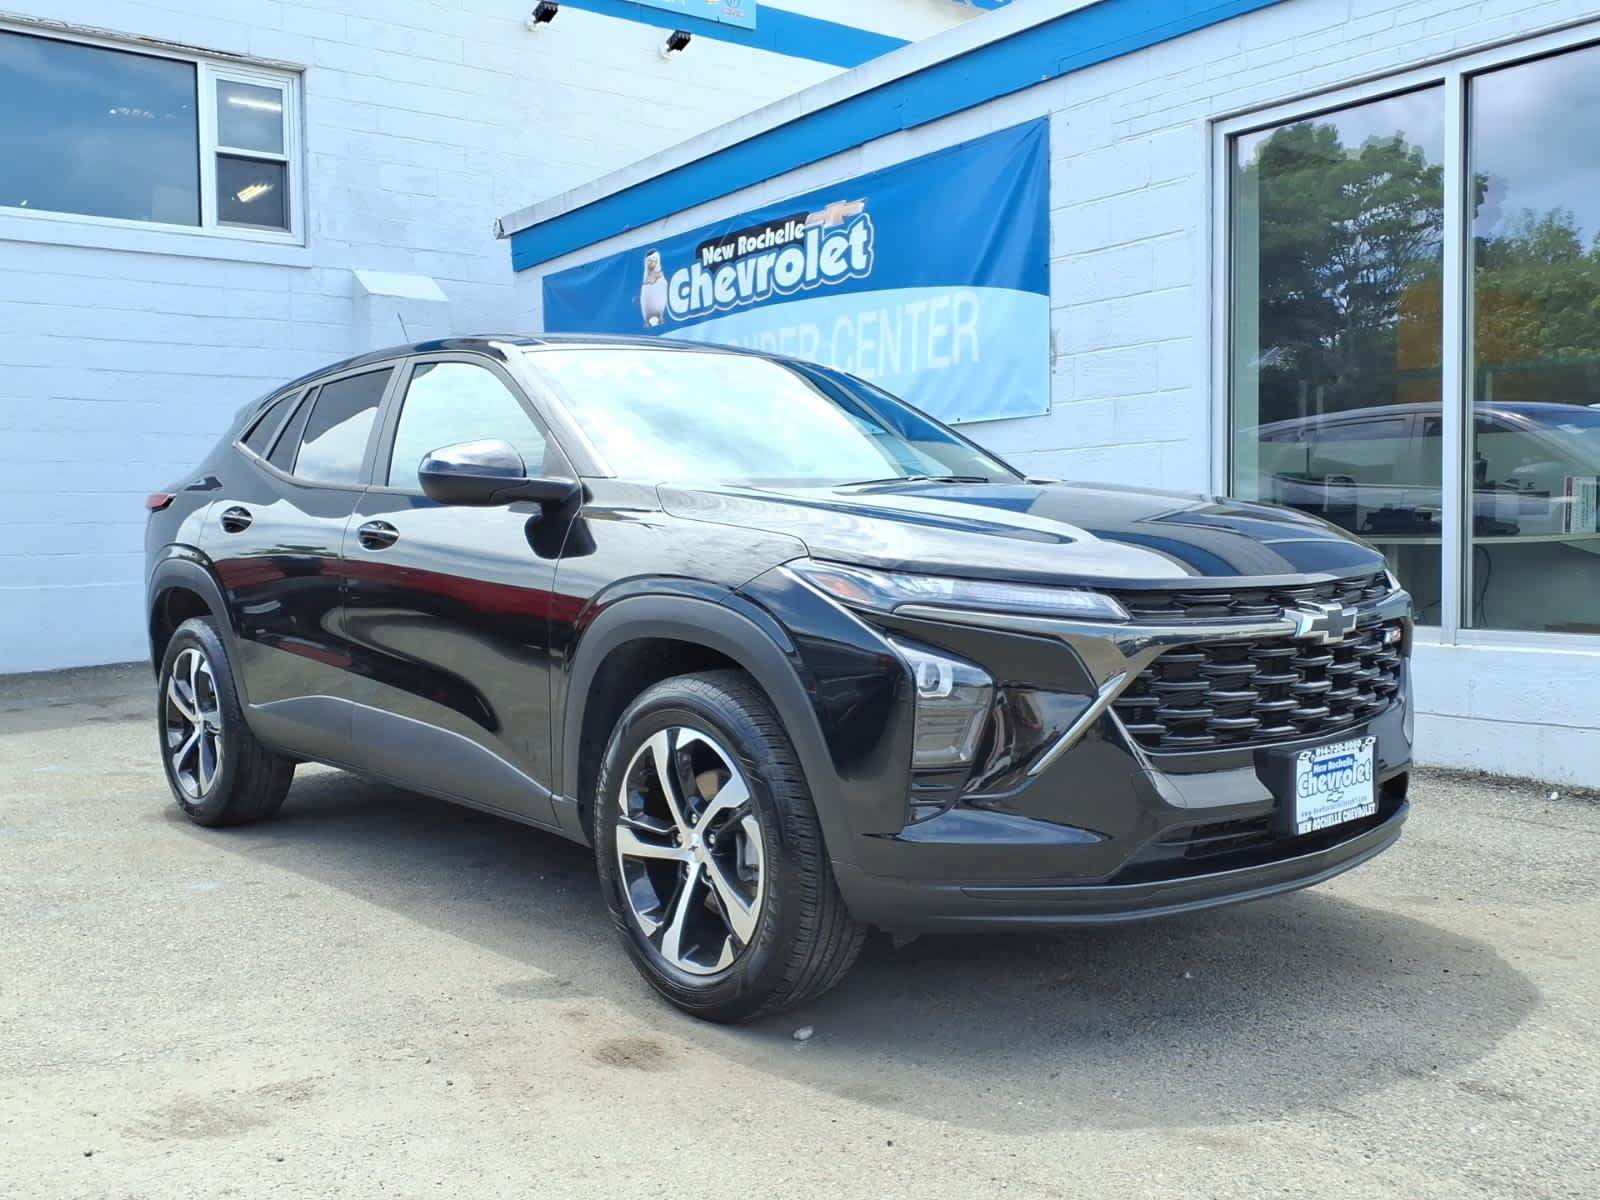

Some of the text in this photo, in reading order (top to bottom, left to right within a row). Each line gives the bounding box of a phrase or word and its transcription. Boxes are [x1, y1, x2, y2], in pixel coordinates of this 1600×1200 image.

[668, 220, 869, 315] Chevrolet
[702, 221, 805, 266] New Rochelle
[831, 290, 981, 378] CENTER
[1297, 757, 1371, 798] Chevrolet
